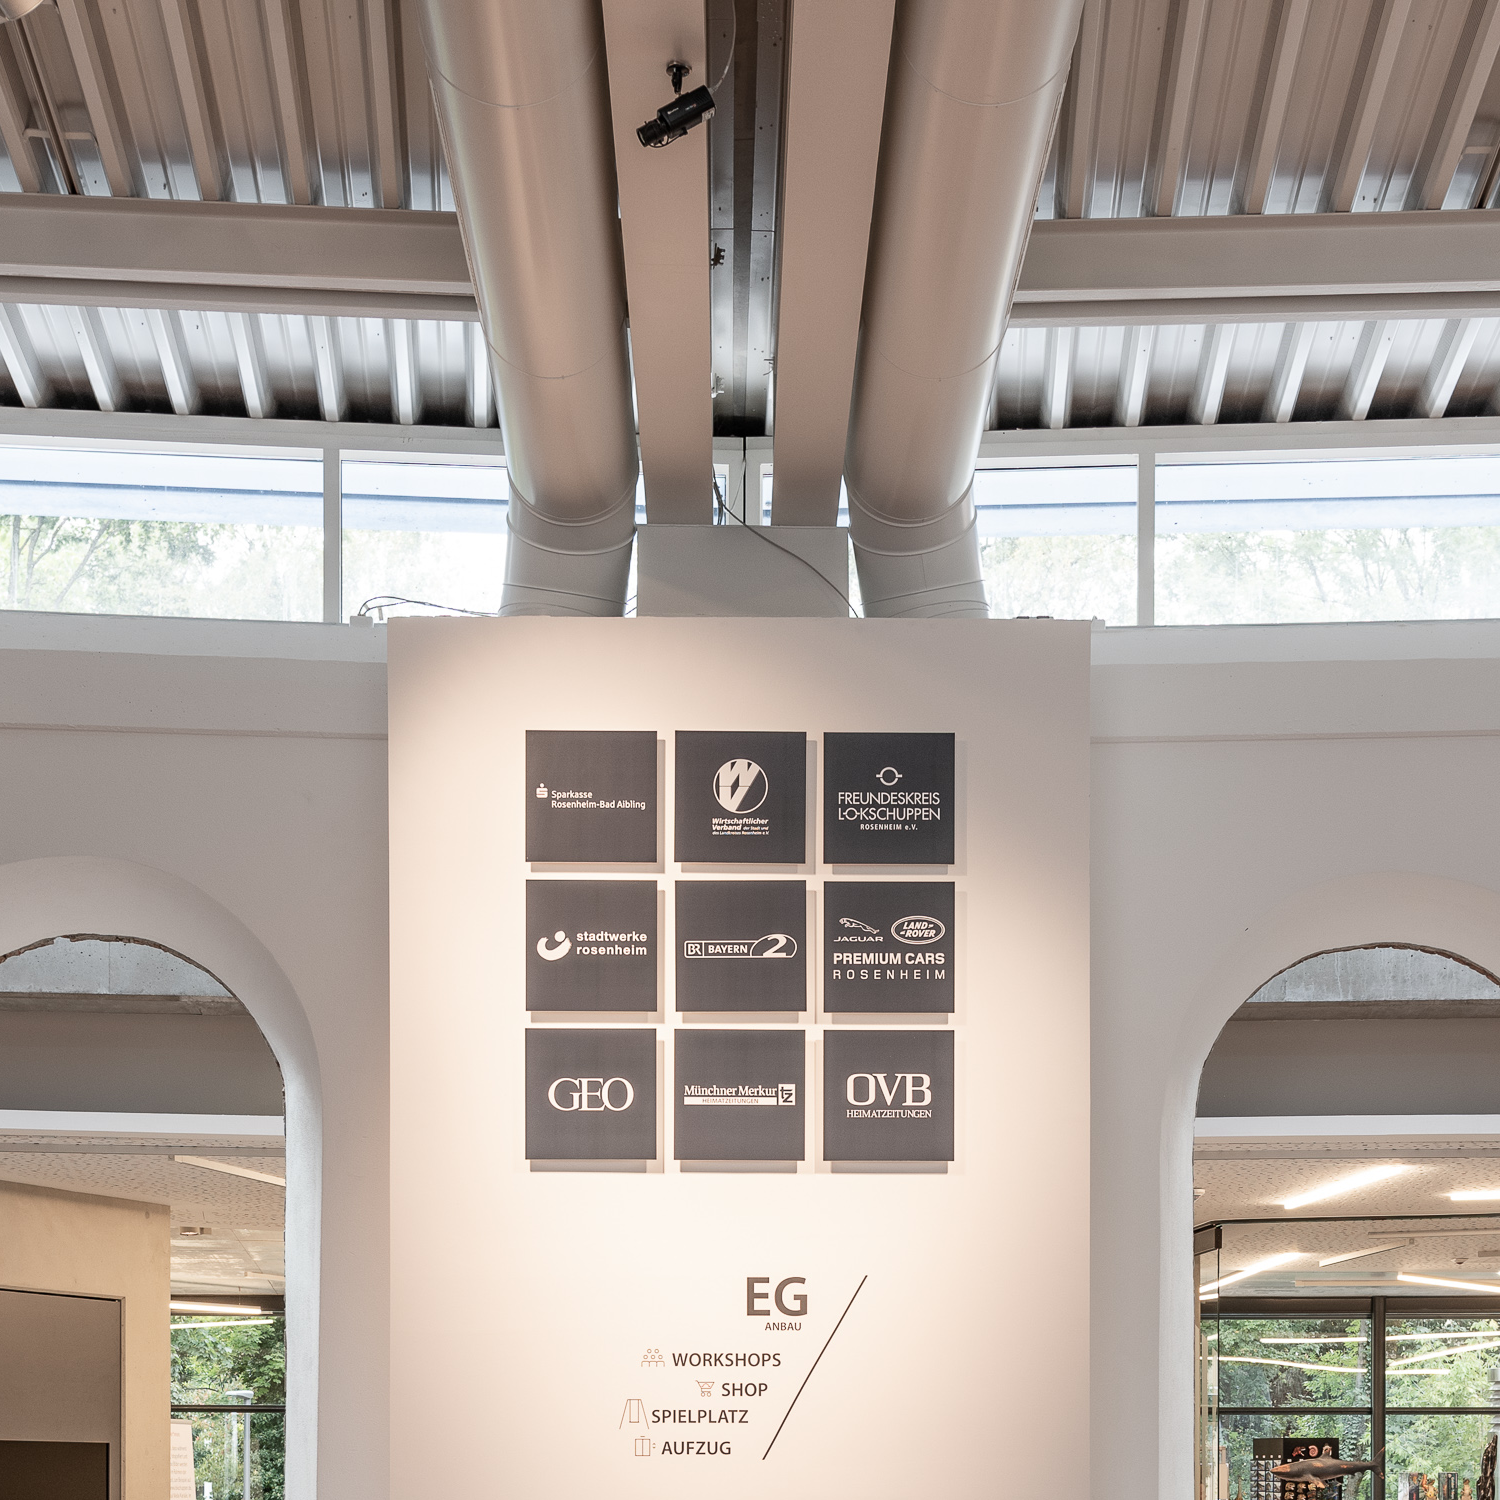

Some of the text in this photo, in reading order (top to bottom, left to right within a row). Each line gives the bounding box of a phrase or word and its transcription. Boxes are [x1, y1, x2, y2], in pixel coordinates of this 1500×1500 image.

[551, 790, 593, 800] Sparkasse
[838, 792, 940, 805] FREUNDESKREIS
[551, 800, 646, 811] Rosenheim-Bad Aibling
[838, 807, 941, 821] LOKSCHUPPEN
[860, 823, 918, 831] ROSENHEIM e.V.
[903, 921, 928, 930] LAND
[576, 930, 648, 942] stadtwerke
[905, 929, 936, 938] ROVER
[576, 944, 647, 955] rosenheim
[687, 935, 788, 957] BR BAYERN 2
[833, 953, 945, 965] PREMIUM CARS
[833, 969, 946, 980] ROSENHEIM
[548, 1077, 634, 1111] GEO
[683, 1085, 778, 1096] Münchner Merkur
[780, 1086, 793, 1103] tz
[846, 1073, 932, 1106] OVB
[846, 1109, 933, 1118] HEIMATZEITUNGEN
[746, 1276, 808, 1317] EG
[764, 1322, 802, 1331] ANBAU
[672, 1352, 782, 1367] WORKSHOPS
[721, 1382, 768, 1397] SHOP
[651, 1409, 749, 1424] SPIELPLATZ
[661, 1441, 732, 1456] AUFZUG
